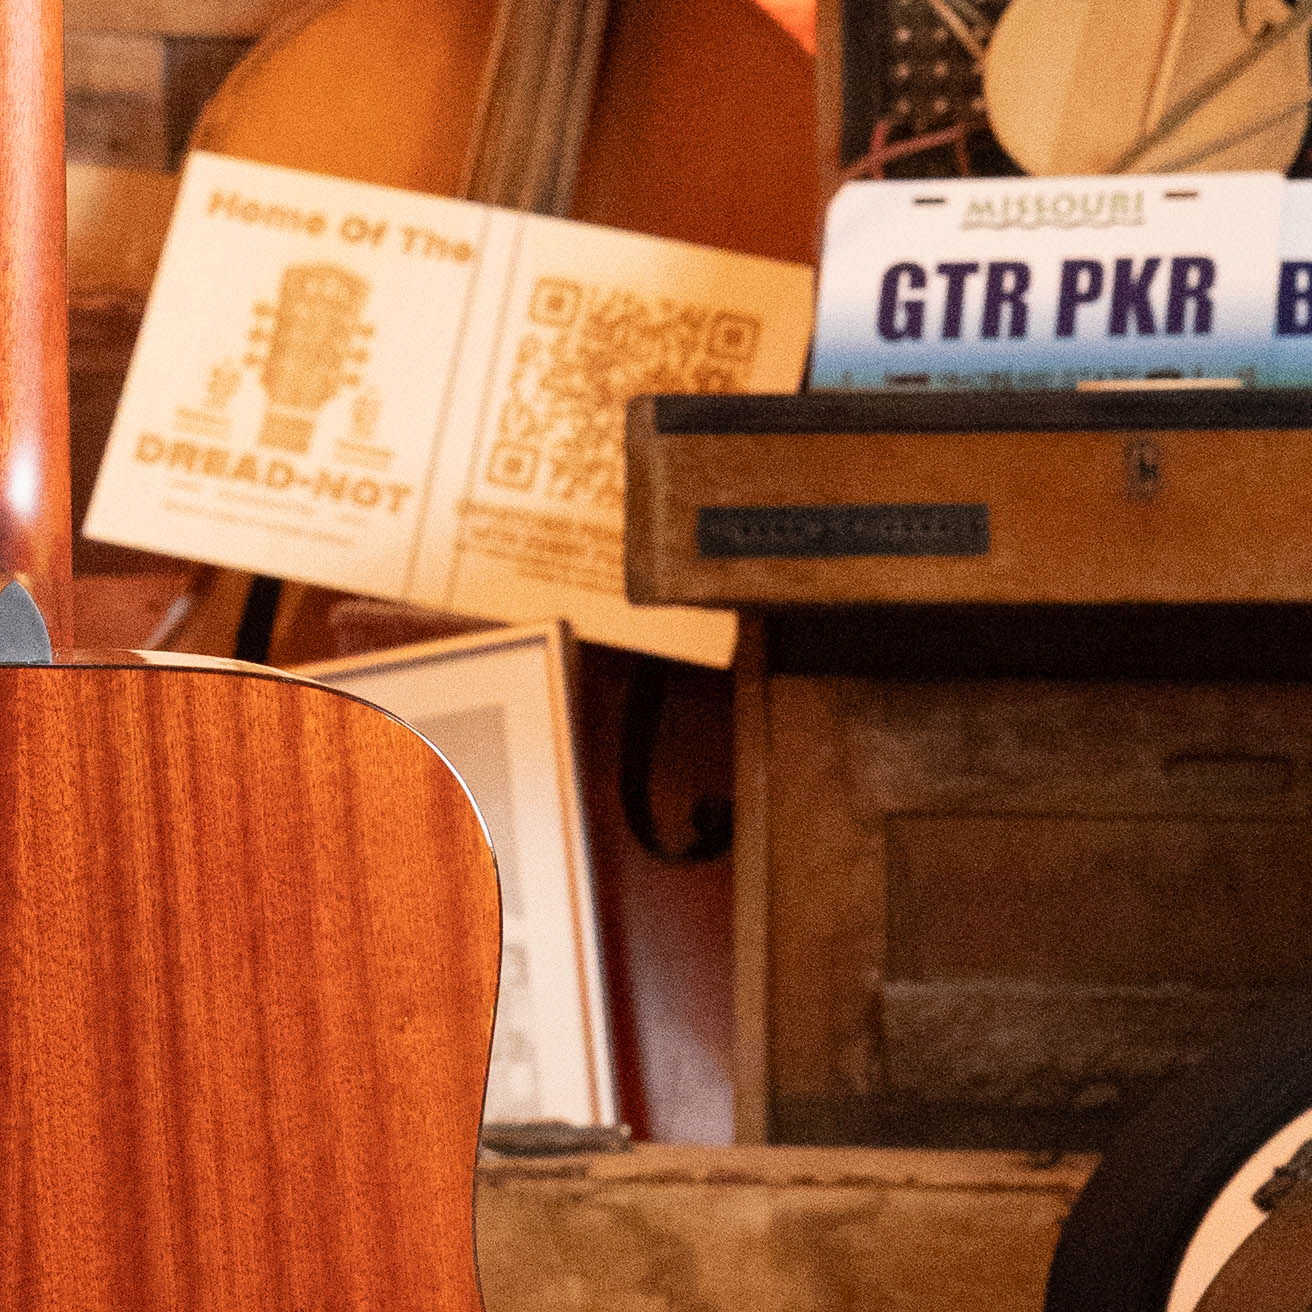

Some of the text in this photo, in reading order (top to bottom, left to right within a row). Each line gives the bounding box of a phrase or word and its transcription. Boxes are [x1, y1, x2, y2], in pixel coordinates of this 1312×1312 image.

[205, 188, 477, 265] Home Of The
[965, 190, 1147, 220] MISSOURI
[875, 256, 1217, 343] GTR PKR
[132, 431, 414, 519] DREAD-NOT
